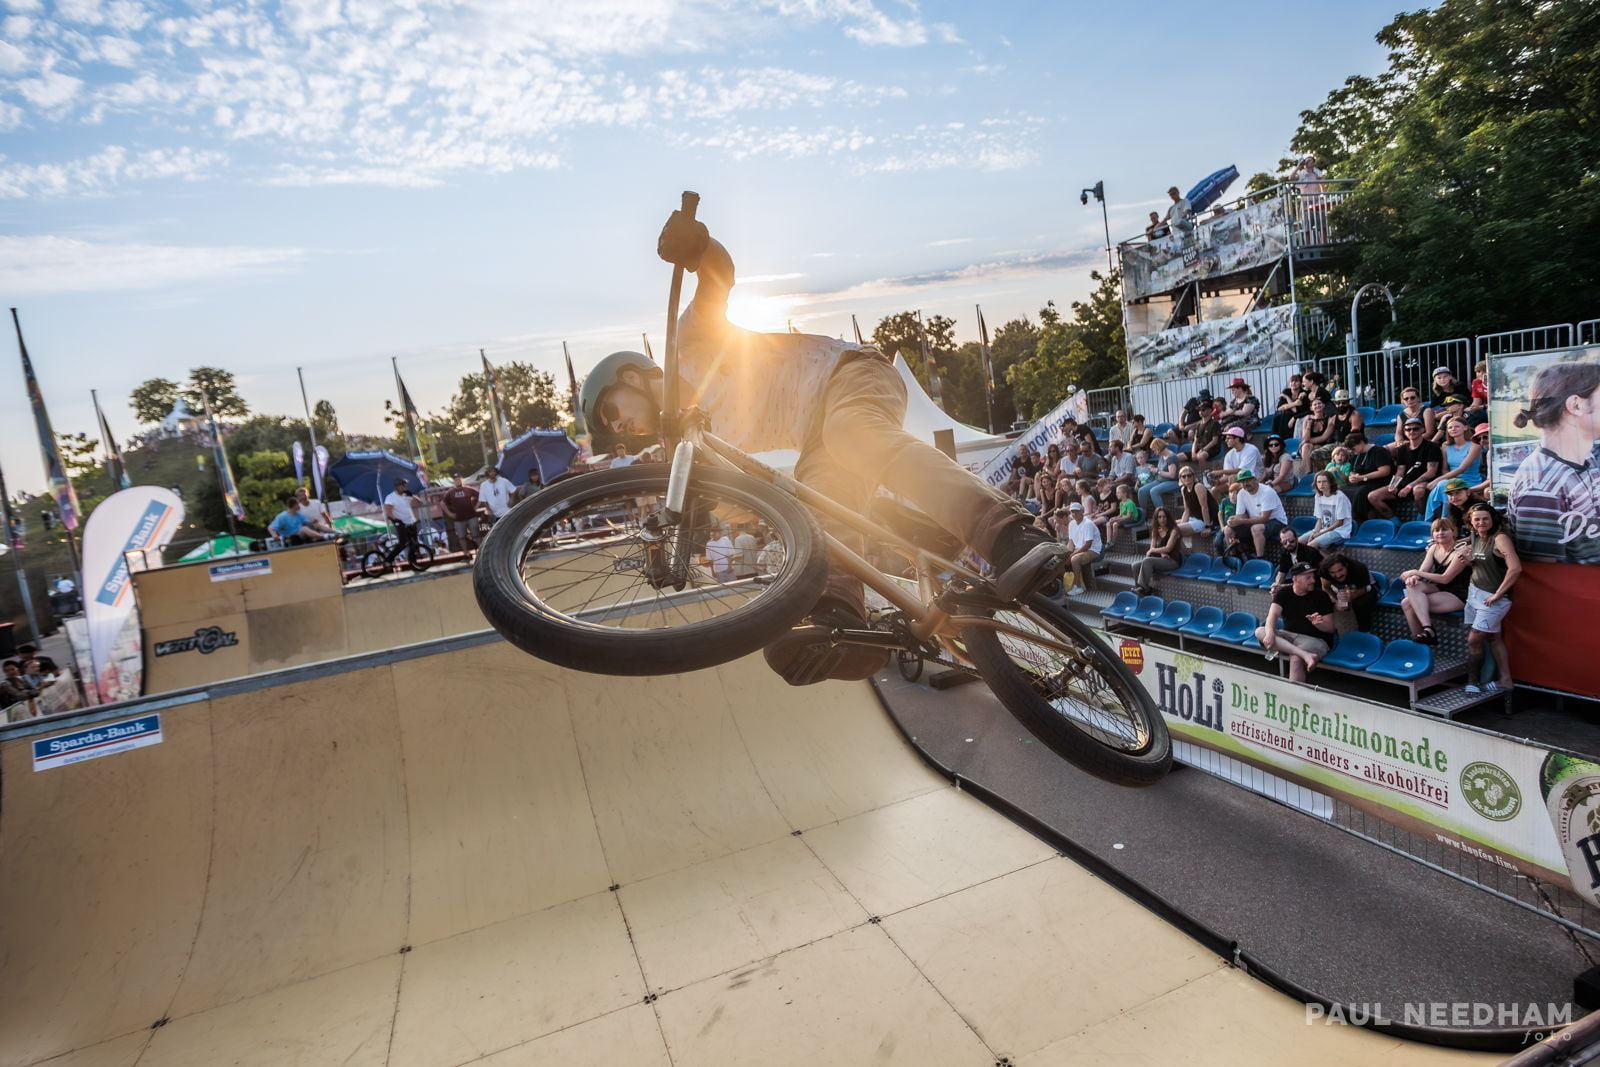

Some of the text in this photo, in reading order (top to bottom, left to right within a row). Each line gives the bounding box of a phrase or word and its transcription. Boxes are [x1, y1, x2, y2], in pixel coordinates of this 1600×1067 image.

[1191, 346, 1206, 356] CUP
[987, 408, 1077, 486] parda portpark
[1155, 662, 1224, 732] HoLi
[1231, 683, 1448, 773] Die Hopfenlimonade
[49, 722, 146, 752] Sparda-Bank
[1231, 720, 1449, 804] erfrischend anders alkoholfrei
